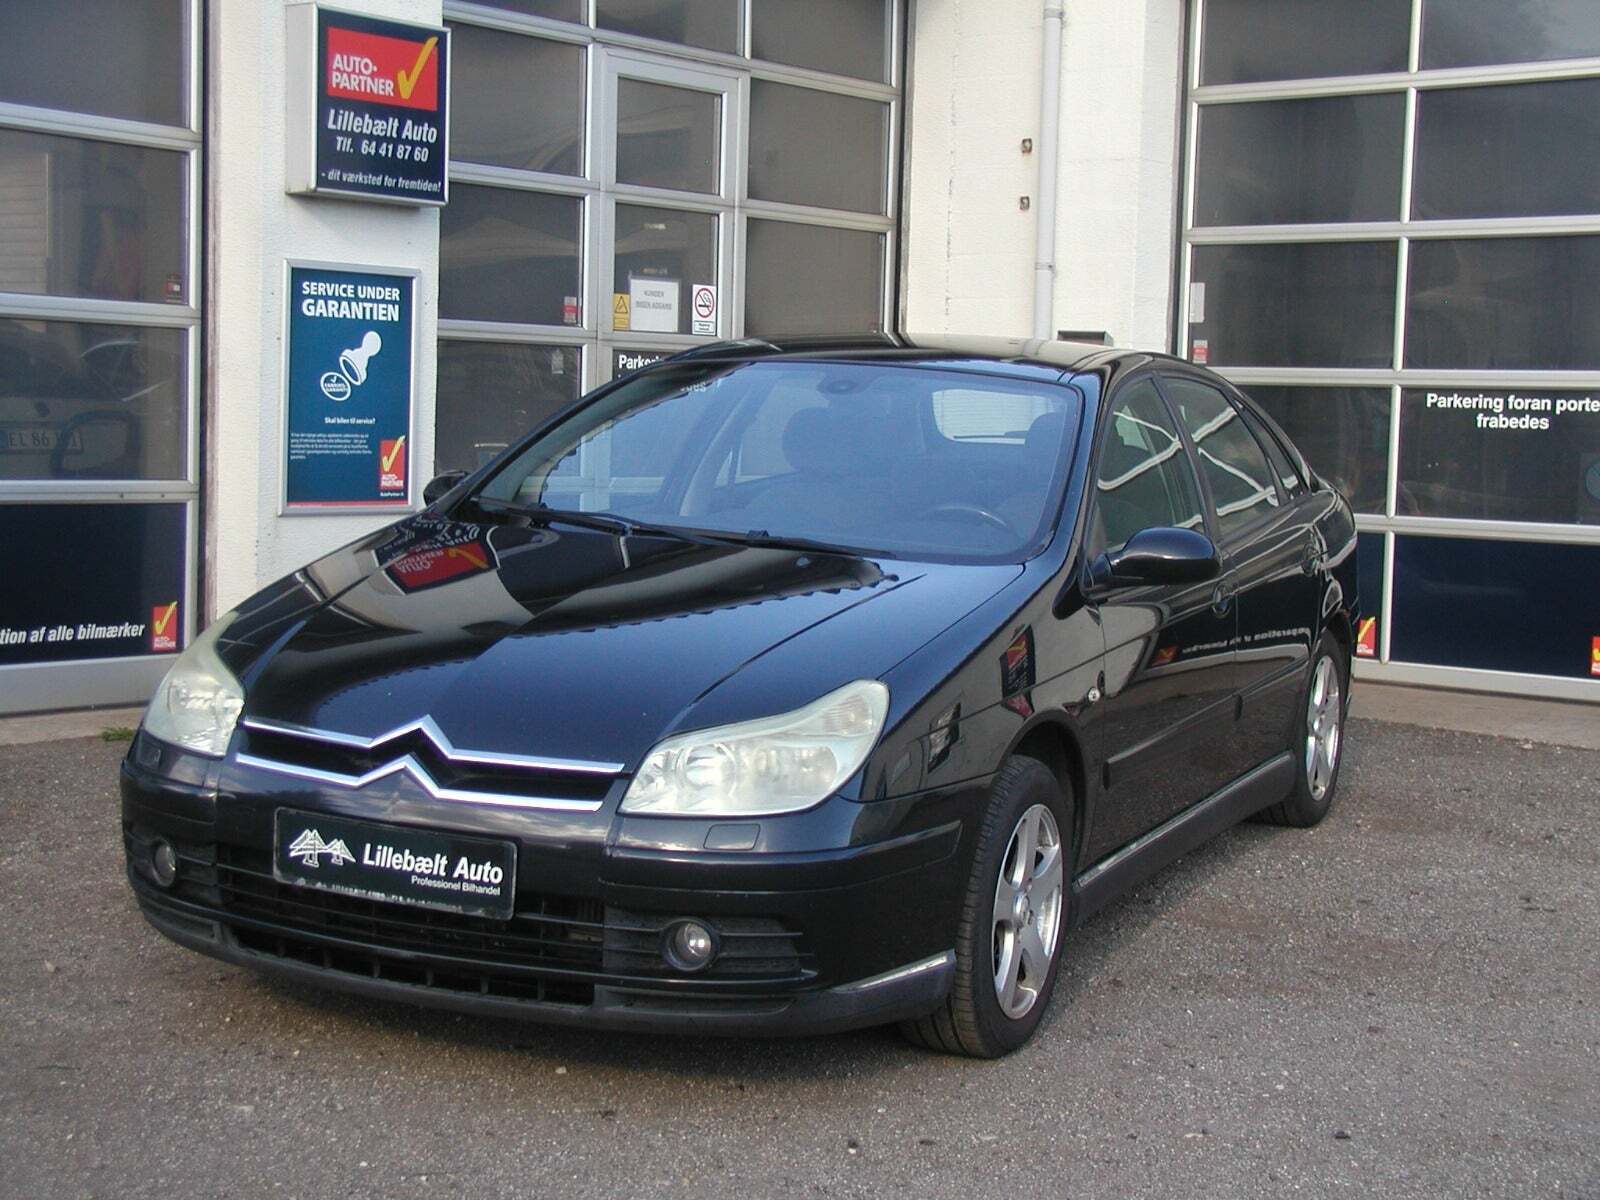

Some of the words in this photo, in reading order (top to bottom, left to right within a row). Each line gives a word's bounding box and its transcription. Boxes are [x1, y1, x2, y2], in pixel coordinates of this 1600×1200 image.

[332, 54, 378, 73] AUTO-
[331, 72, 395, 97] PARTNER
[327, 108, 399, 138] Lillebælt
[402, 120, 438, 143] Auto
[336, 136, 353, 153] Tlf.
[361, 140, 376, 156] 64
[379, 142, 393, 158] 41
[397, 145, 411, 160] 87
[414, 147, 429, 162] 60
[328, 169, 341, 181] dit
[342, 171, 382, 186] værksted
[384, 176, 396, 188] for
[398, 177, 441, 192] fremtiden!
[302, 281, 355, 298] SERVICE
[358, 285, 400, 301] UNDER
[302, 298, 399, 322] GARANTIEN
[1426, 393, 1504, 412] Parkering
[1508, 394, 1551, 411] foran
[1476, 413, 1550, 429] frabedes
[30, 626, 47, 643] af
[49, 624, 74, 641] alle
[77, 621, 146, 640] bilmærker
[362, 843, 449, 877] Lillebælt
[453, 857, 504, 884] Auto
[411, 874, 461, 891] Professionel
[462, 881, 501, 896] Bilhandel
